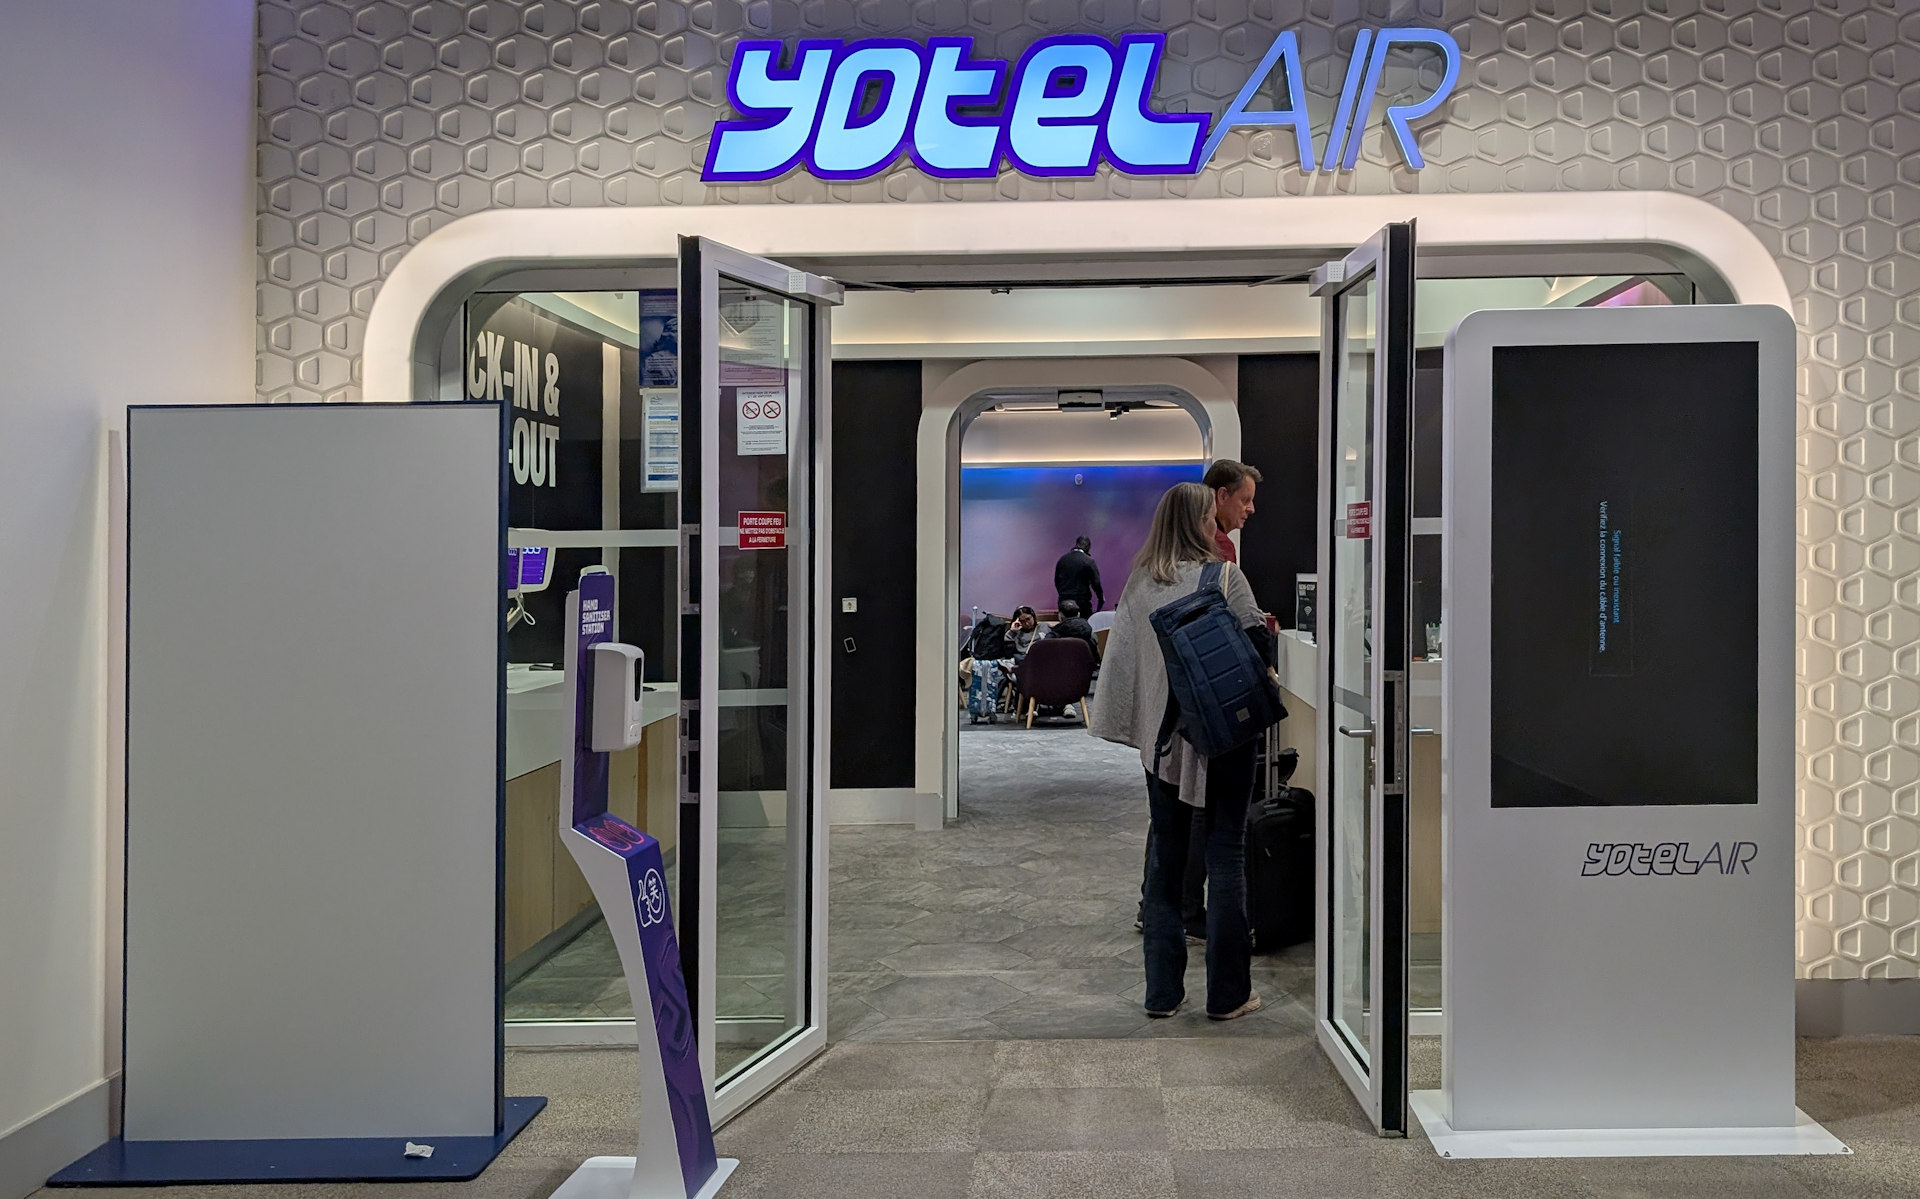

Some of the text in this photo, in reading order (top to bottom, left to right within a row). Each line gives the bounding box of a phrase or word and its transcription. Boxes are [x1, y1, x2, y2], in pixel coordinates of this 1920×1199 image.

[544, 352, 560, 417] &
[743, 517, 782, 526] PORTE COUPE FEU
[1600, 501, 1608, 530] Vérifiez
[1600, 530, 1607, 538] la
[1612, 530, 1621, 552] Signal
[1613, 554, 1621, 574] faible
[1600, 579, 1607, 590] du
[1613, 576, 1620, 586] ou
[582, 599, 599, 611] HAND
[582, 610, 611, 623] SANITISER
[582, 622, 605, 635] STATION
[1599, 612, 1607, 653] d'antenne.
